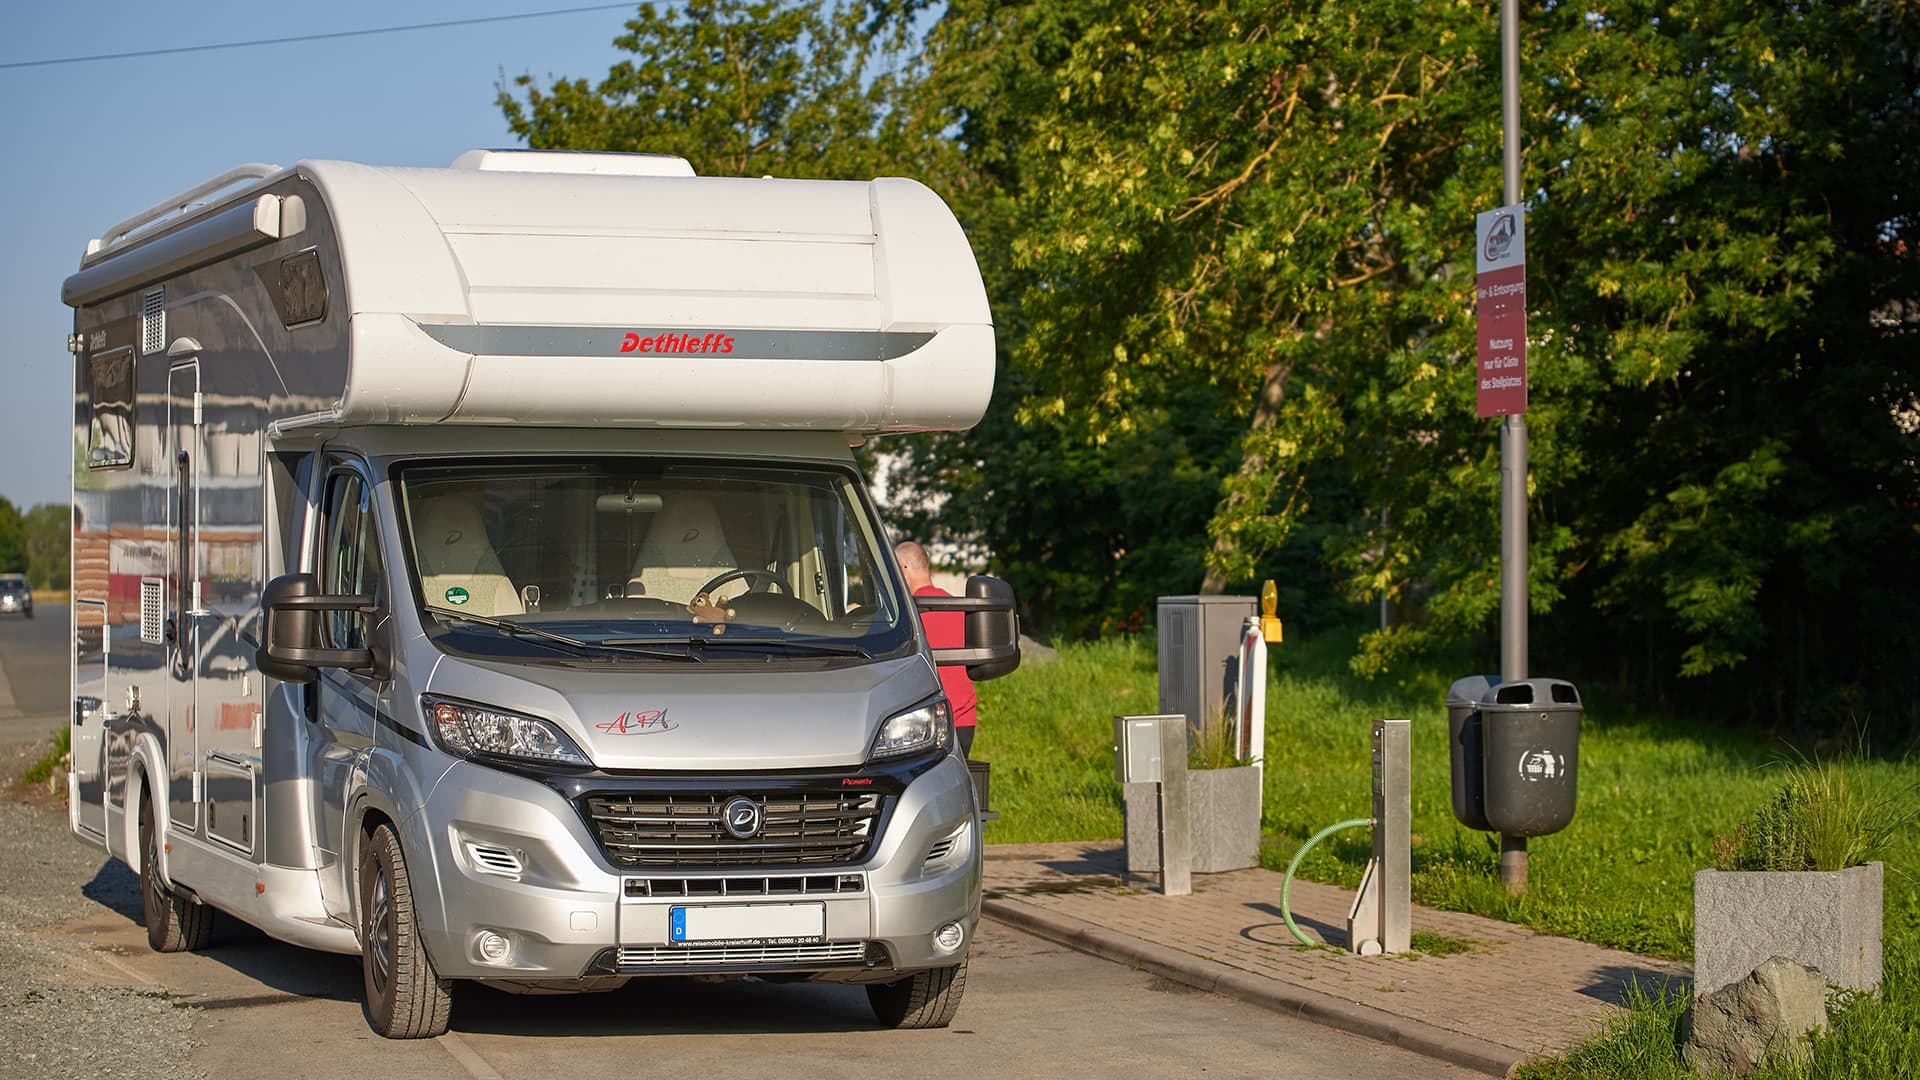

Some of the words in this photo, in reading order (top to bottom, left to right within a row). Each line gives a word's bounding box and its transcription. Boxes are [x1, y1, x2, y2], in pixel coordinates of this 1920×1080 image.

[1493, 282, 1524, 297] Entsorgung
[620, 332, 735, 354] Dethleffs
[1489, 339, 1513, 350] Nutzung
[1484, 360, 1493, 370] nur
[1494, 357, 1502, 368] für
[1503, 356, 1519, 368] Gäste
[1481, 378, 1491, 390] des
[1492, 376, 1522, 390] Stellplatzes
[676, 927, 682, 935] D
